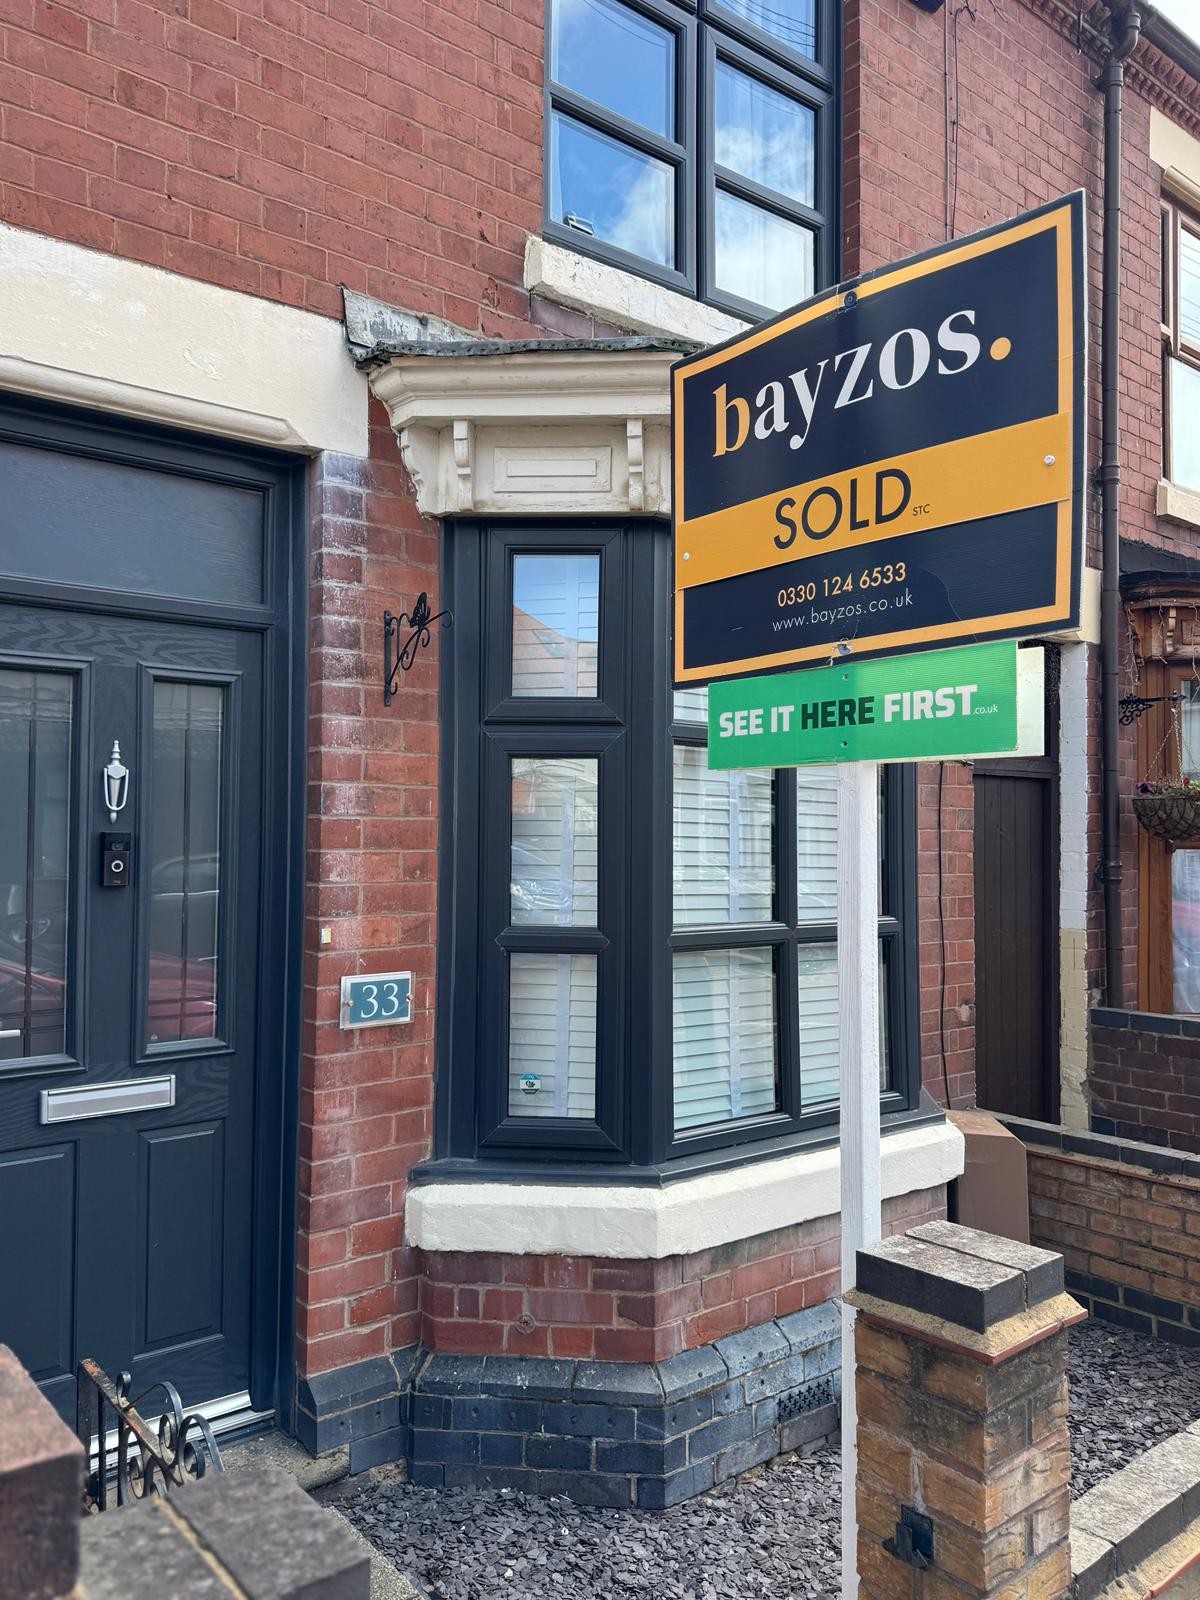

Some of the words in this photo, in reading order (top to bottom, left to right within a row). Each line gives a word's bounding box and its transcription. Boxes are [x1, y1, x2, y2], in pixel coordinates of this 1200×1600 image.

[712, 309, 1012, 457] bayzos.
[773, 468, 912, 550] SOLD
[912, 503, 931, 517] STC
[777, 582, 816, 607] 0330
[823, 572, 854, 597] 124
[859, 561, 906, 589] 6533
[772, 587, 914, 632] www.bayzos.co.uk
[719, 708, 764, 738] SEE
[770, 704, 795, 733] IT
[800, 695, 875, 730] HERE
[360, 982, 399, 1018] 33
